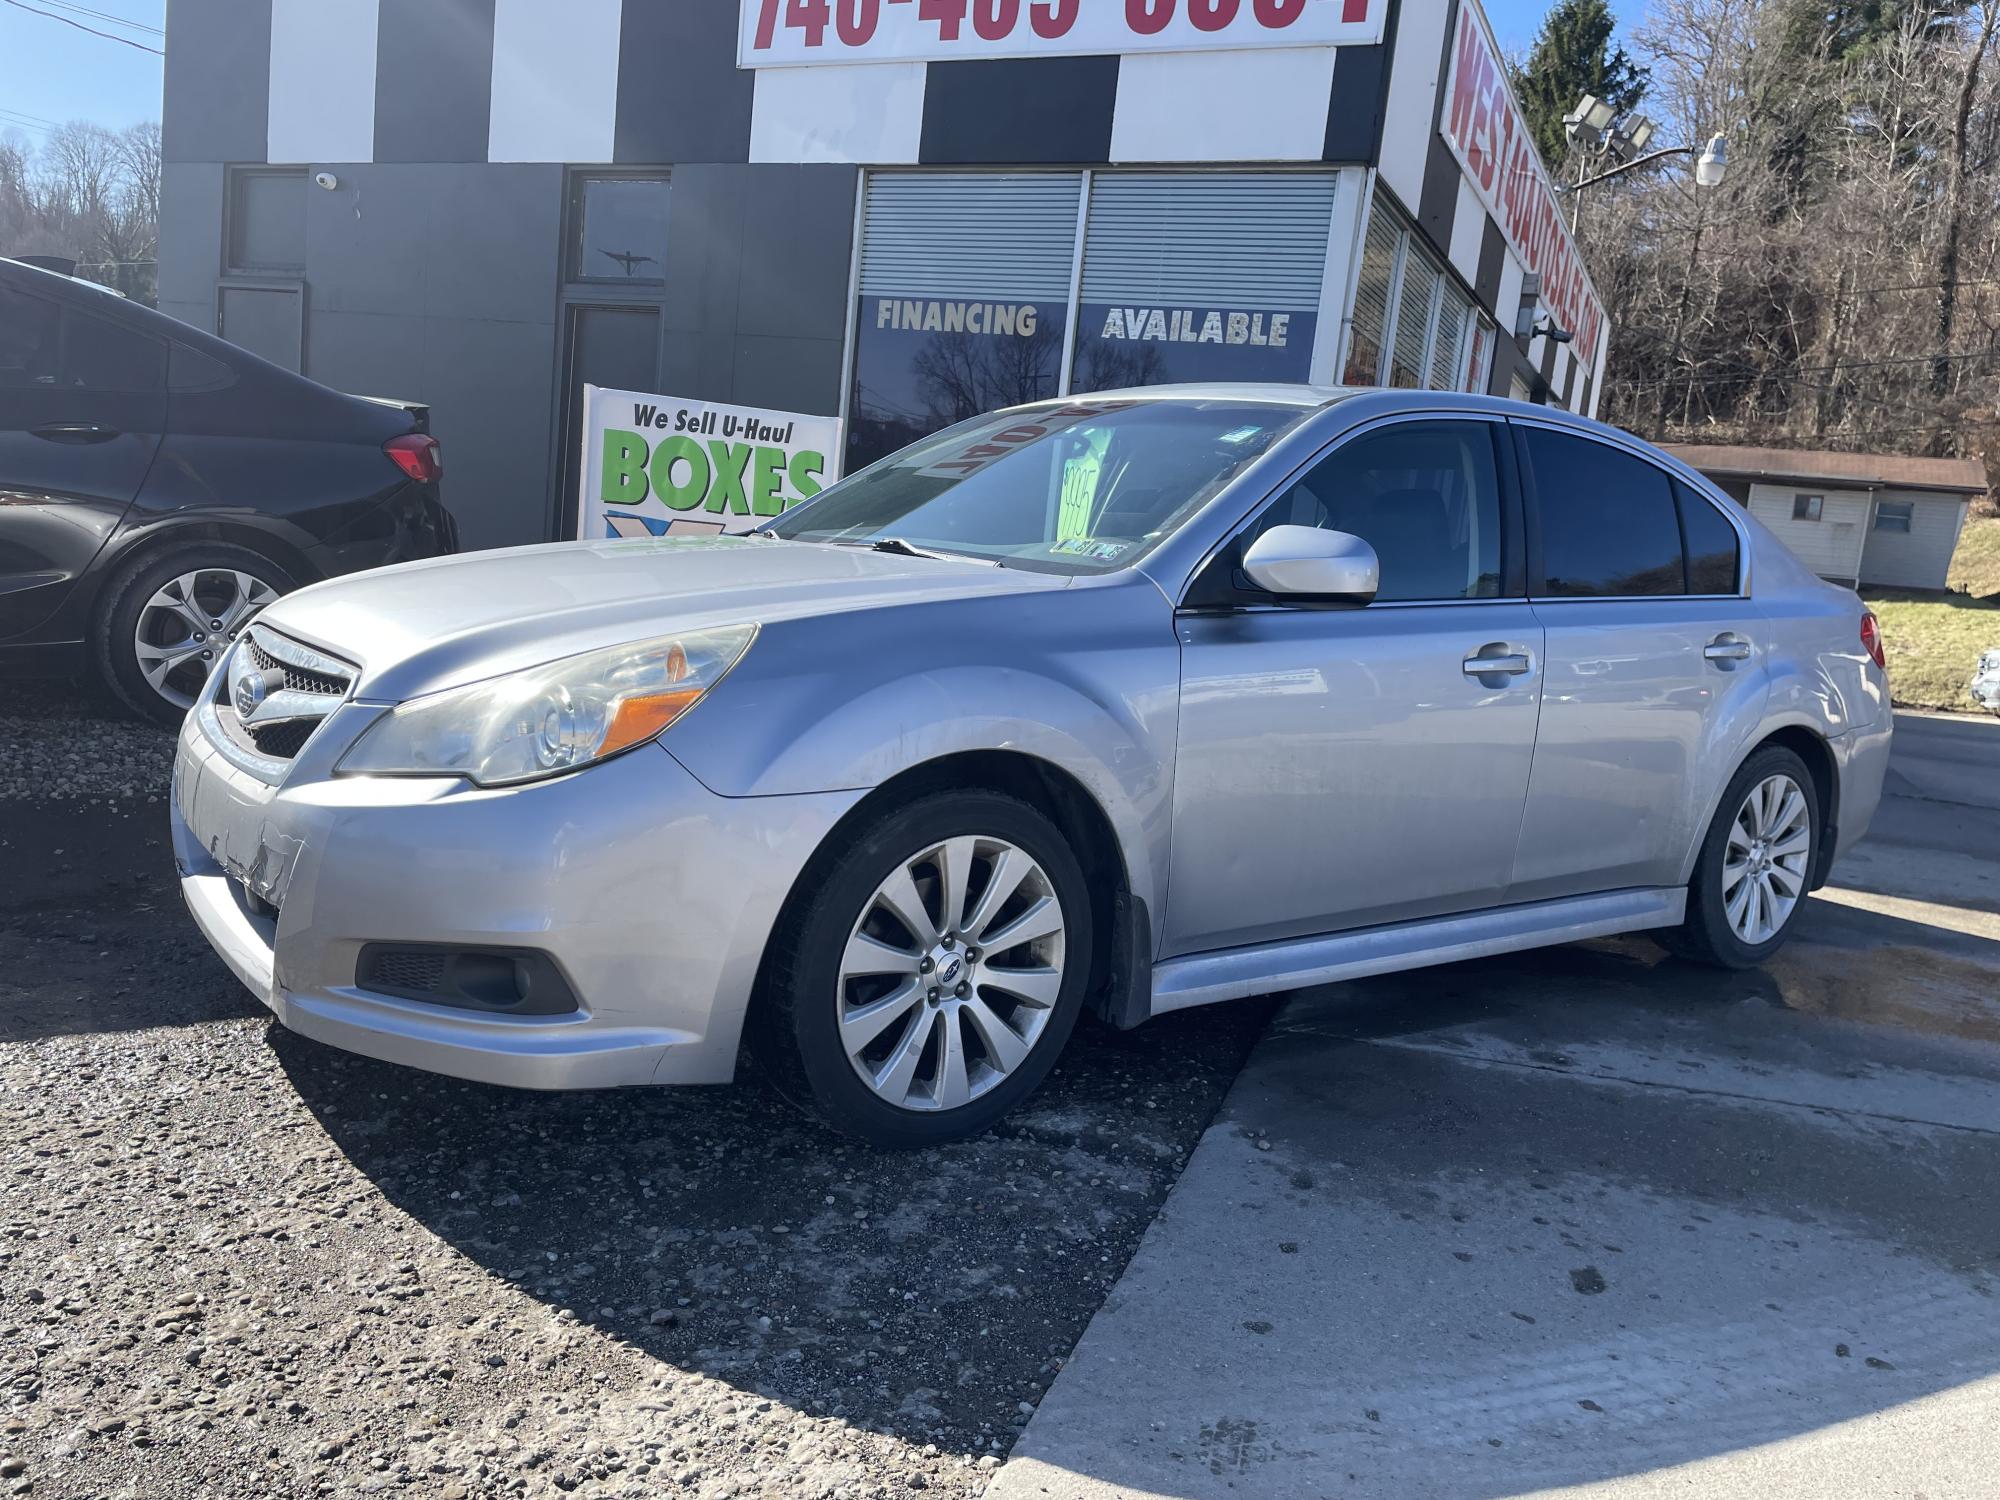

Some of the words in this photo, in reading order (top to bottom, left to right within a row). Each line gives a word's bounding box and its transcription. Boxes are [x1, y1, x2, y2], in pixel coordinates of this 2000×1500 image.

[877, 299, 1037, 337] FINANCING
[1102, 308, 1288, 347] AVAILABLE
[634, 403, 668, 429] We
[674, 409, 717, 435] Sell
[722, 415, 795, 444] U-Haul
[601, 428, 824, 517] BOXES
